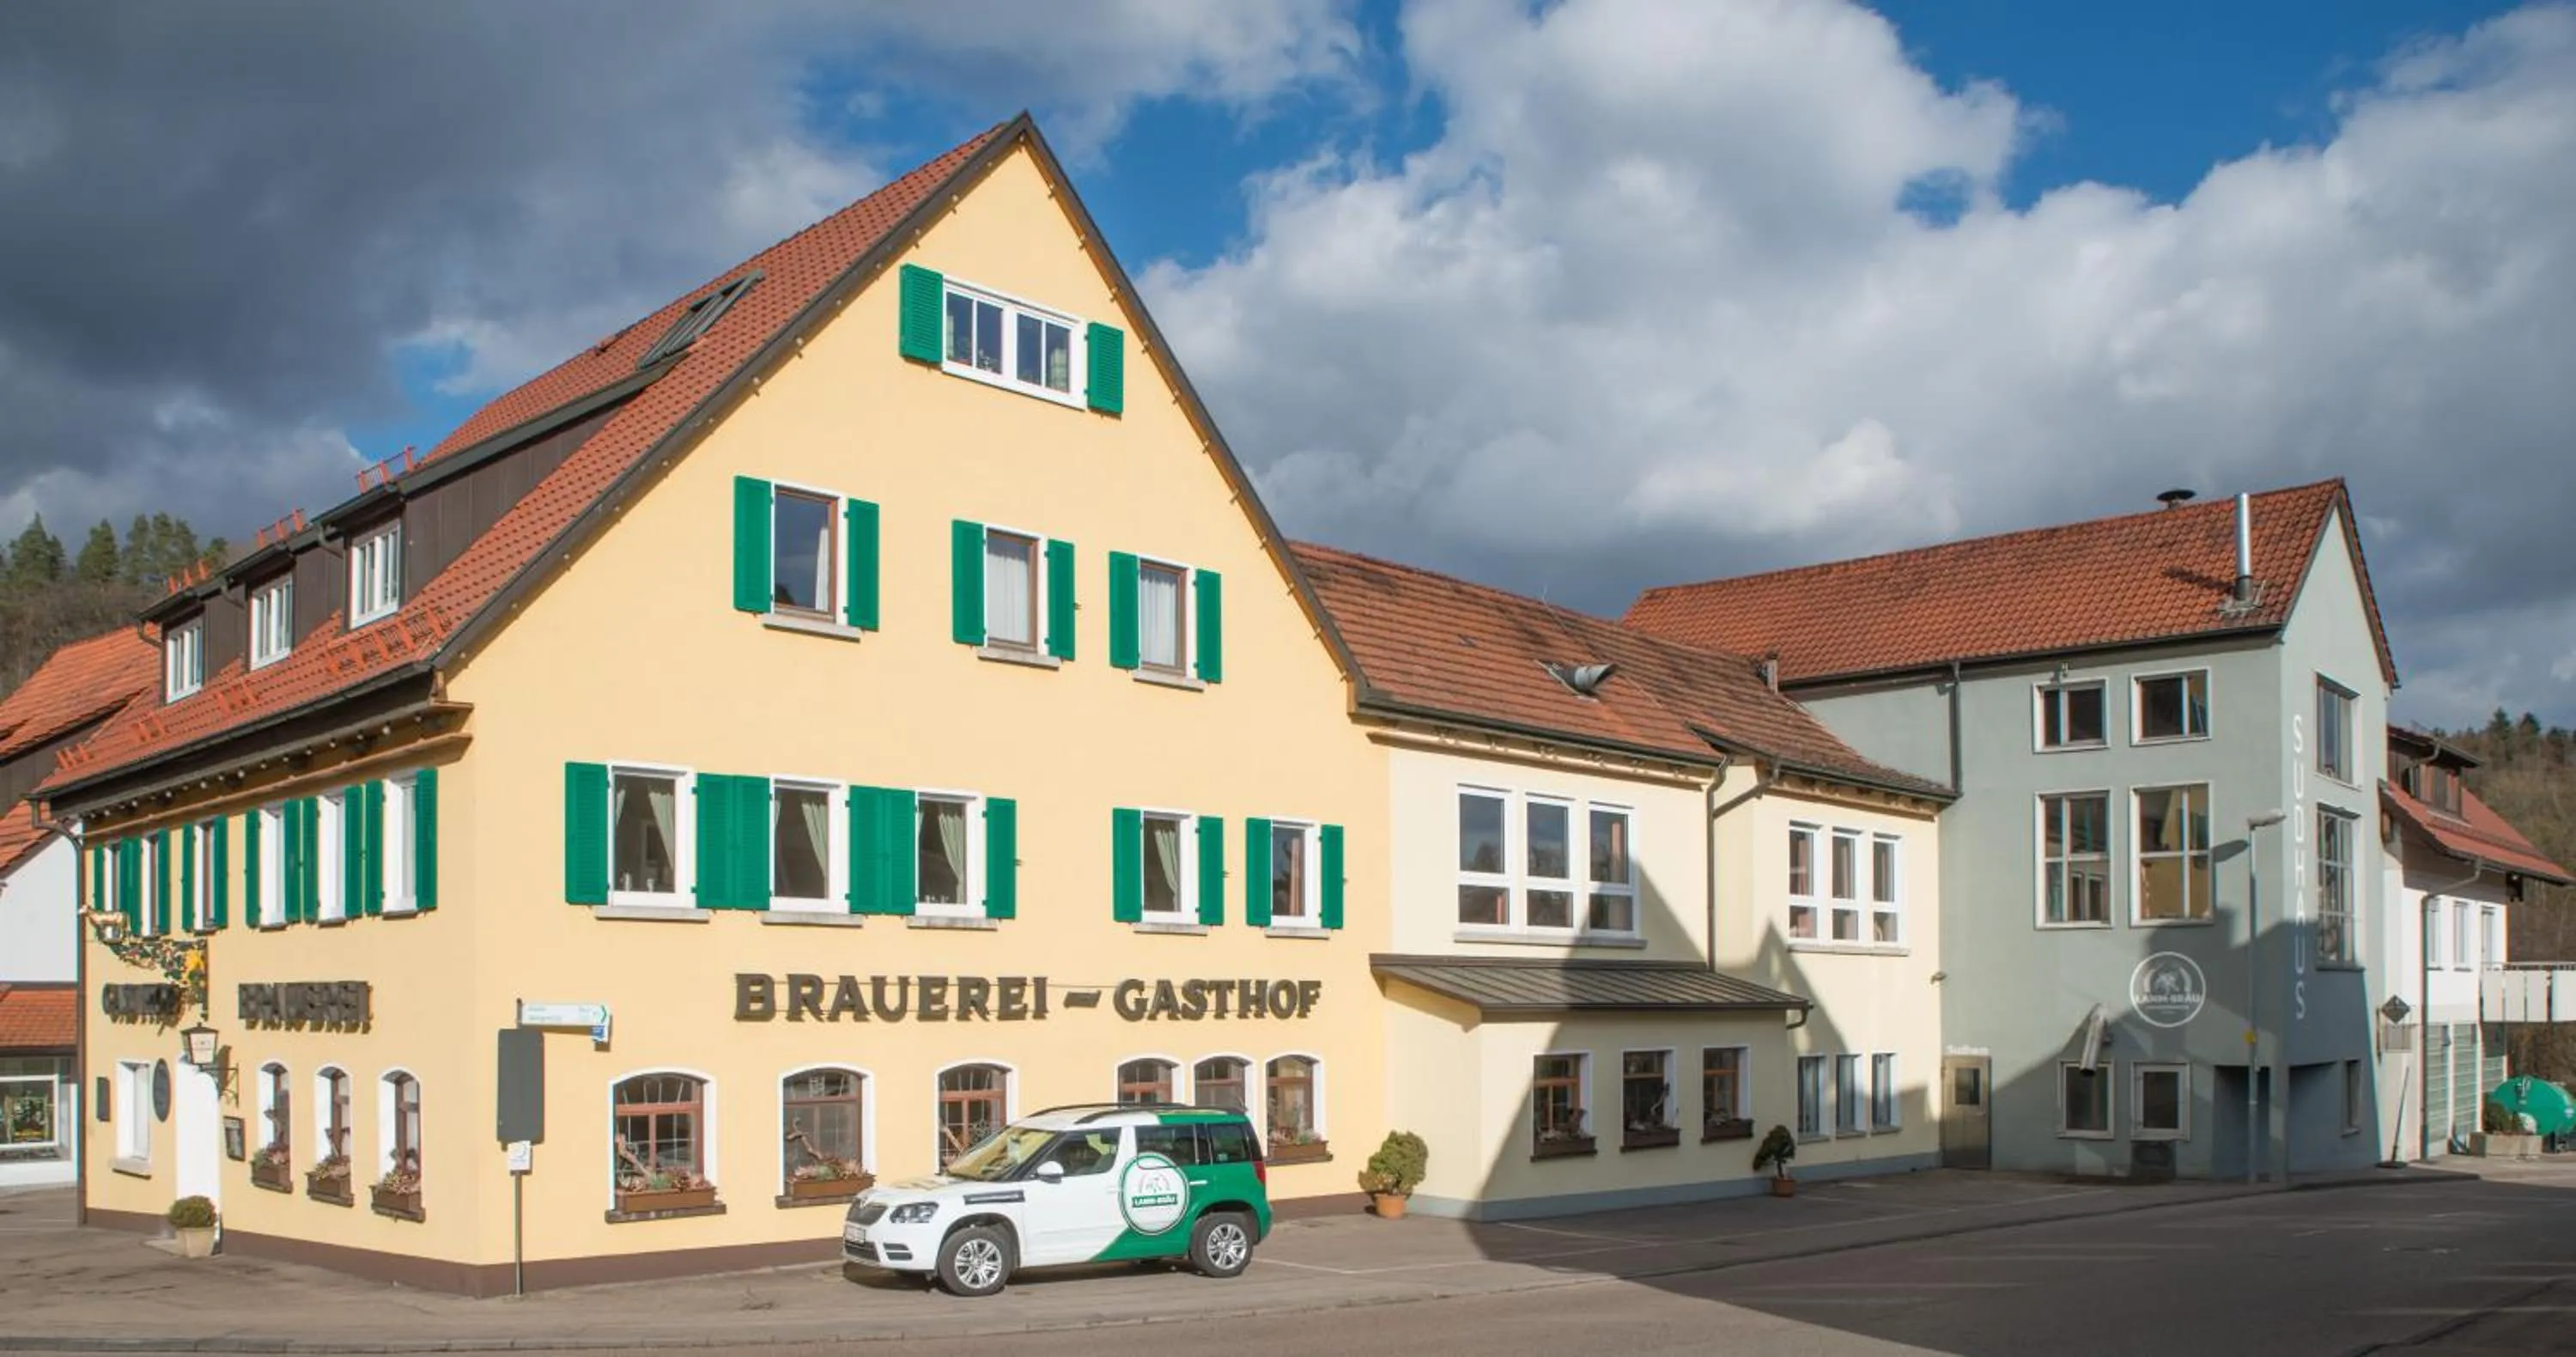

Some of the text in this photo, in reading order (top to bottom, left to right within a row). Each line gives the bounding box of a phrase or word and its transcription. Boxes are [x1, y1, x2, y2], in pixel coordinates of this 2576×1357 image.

[2293, 714, 2306, 1020] SUDHAUS
[733, 973, 1049, 1022] BRAUEREI
[1114, 978, 1322, 1022] GASTHOF
